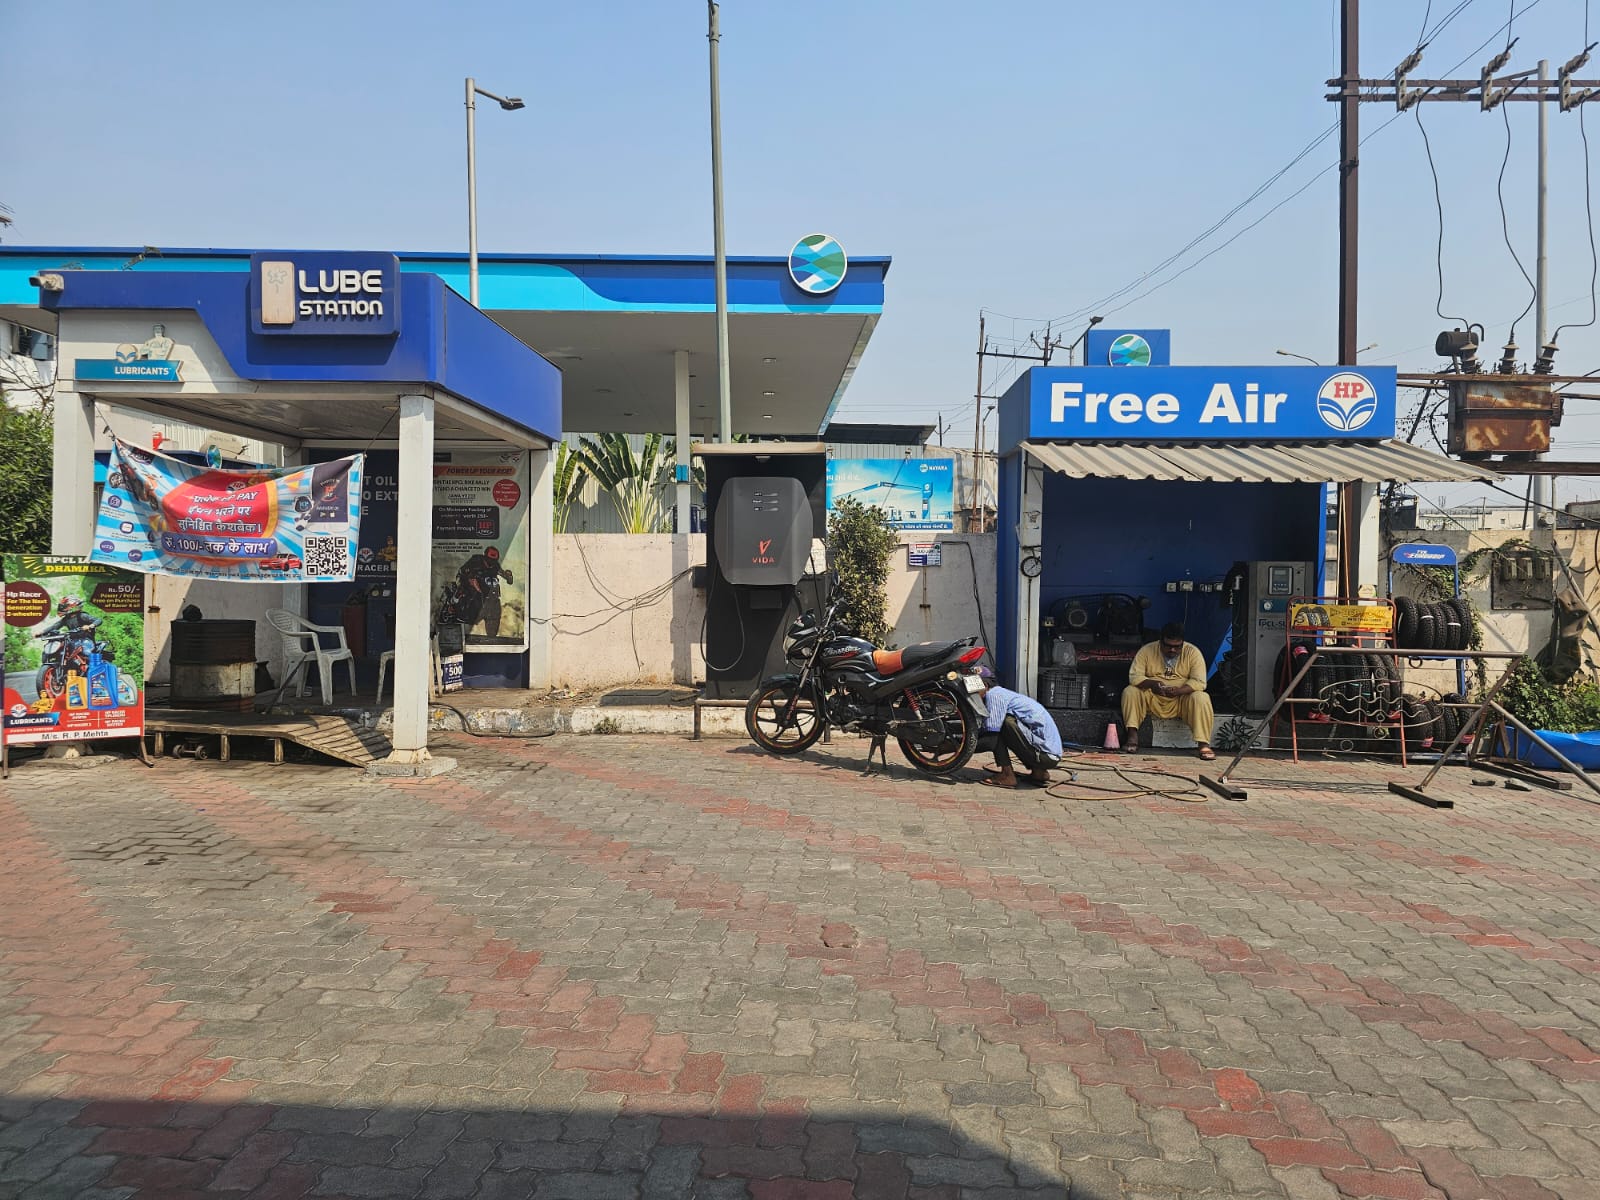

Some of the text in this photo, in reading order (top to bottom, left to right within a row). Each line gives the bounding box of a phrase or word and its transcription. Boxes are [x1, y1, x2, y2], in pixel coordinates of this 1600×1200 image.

[299, 270, 383, 293] LUBE
[300, 301, 383, 315] STATION
[115, 366, 169, 375] LUBRICANTS
[1333, 381, 1365, 399] HP
[1051, 383, 1288, 423] Free Air
[375, 476, 397, 486] OIL
[236, 491, 259, 501] PAY
[376, 491, 399, 501] EXT
[237, 506, 252, 516] पर
[204, 541, 226, 554] तक
[228, 538, 242, 554] के
[118, 585, 141, 593] 50/-
[10, 717, 54, 725] LUBRICANTS
[83, 730, 109, 738] Mehta
